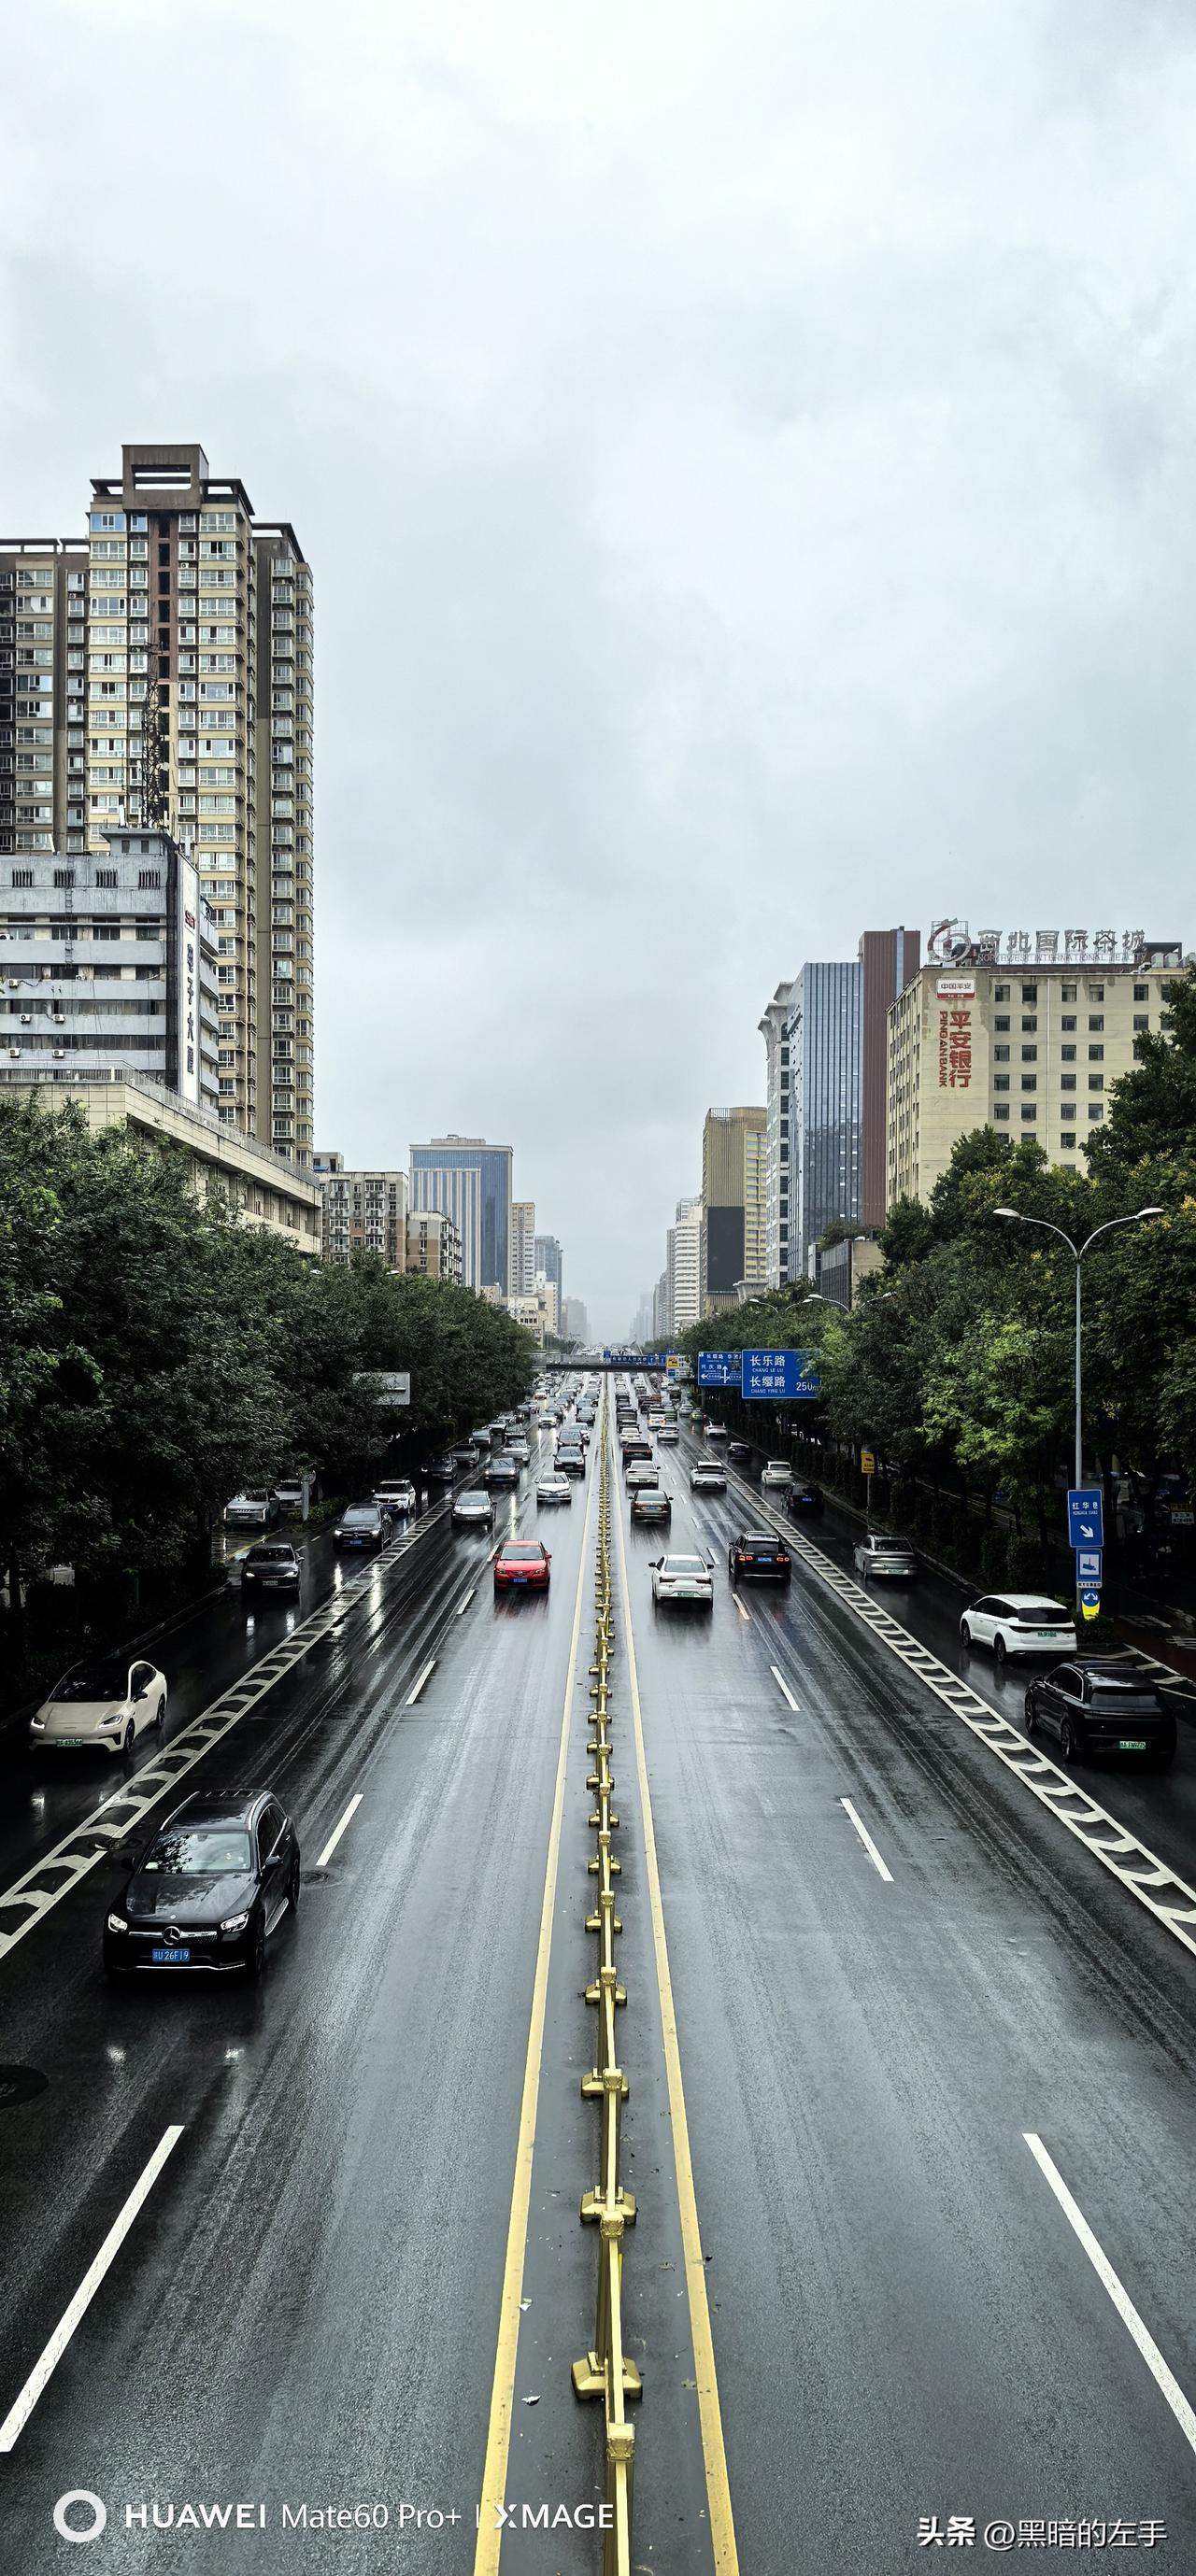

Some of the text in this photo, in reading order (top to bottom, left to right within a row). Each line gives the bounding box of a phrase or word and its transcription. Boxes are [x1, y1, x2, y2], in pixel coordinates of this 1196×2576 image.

[949, 1011, 972, 1088] 平安银行
[749, 1355, 786, 1366] 长乐路
[749, 1376, 786, 1387] 长缨路
